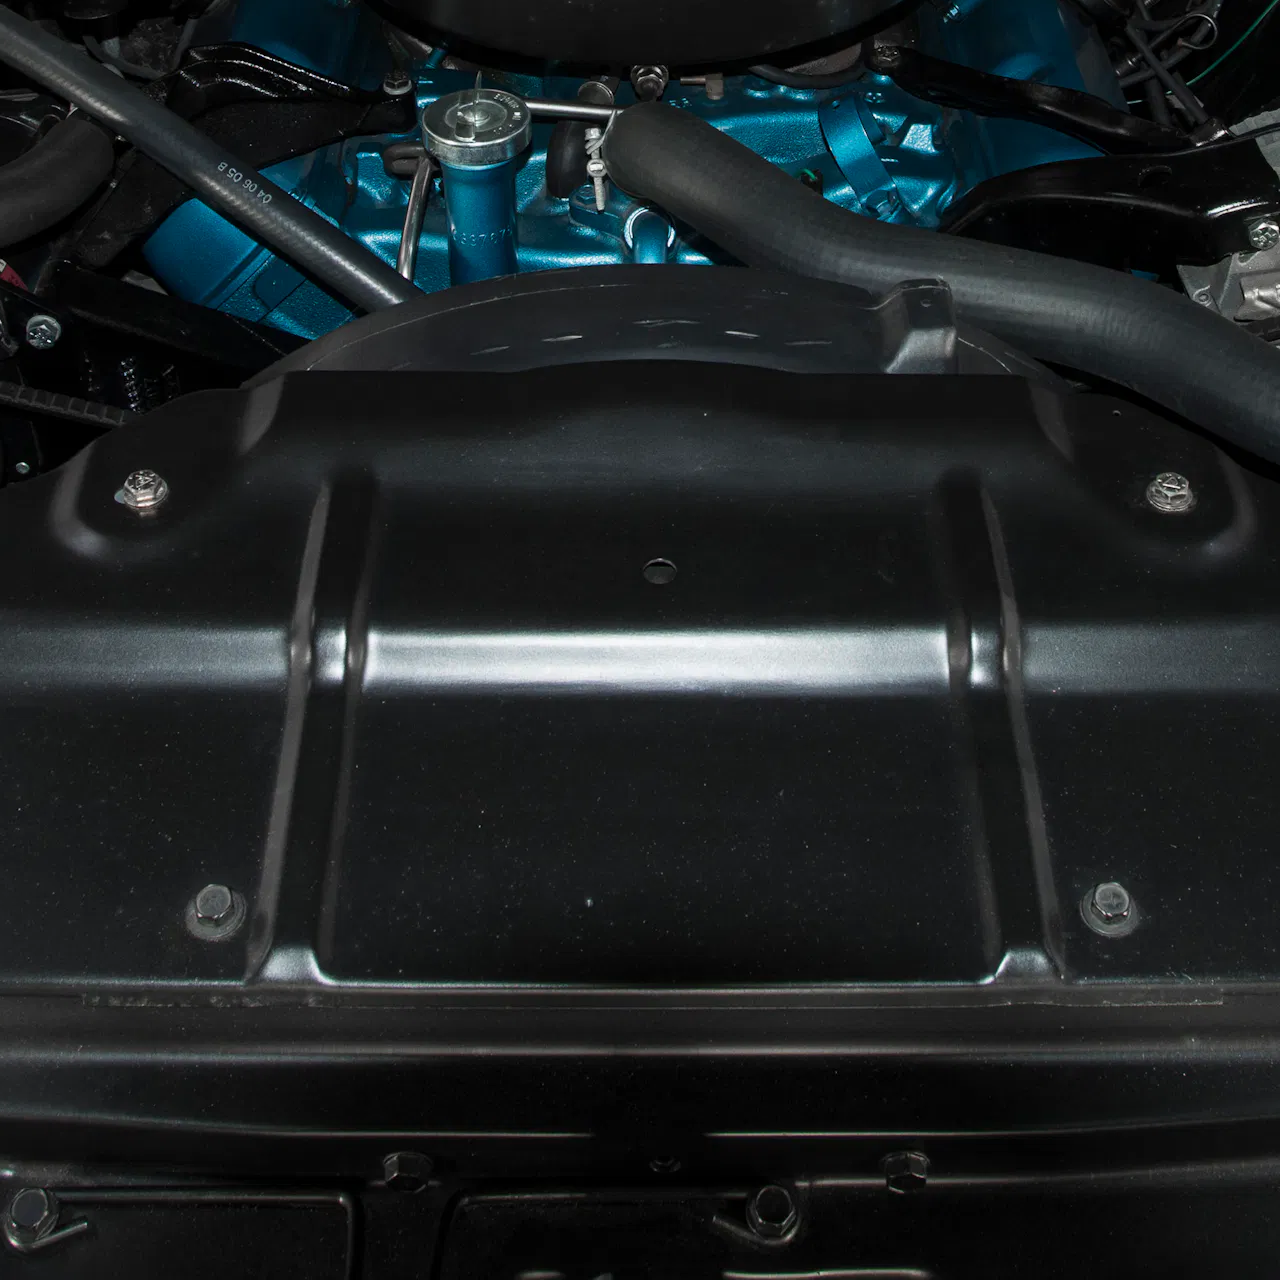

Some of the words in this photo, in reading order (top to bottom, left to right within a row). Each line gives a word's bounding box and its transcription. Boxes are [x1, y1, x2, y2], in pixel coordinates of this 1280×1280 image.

[217, 161, 228, 172] B
[226, 167, 243, 183] 05
[242, 178, 258, 193] 06
[256, 189, 272, 206] 04
